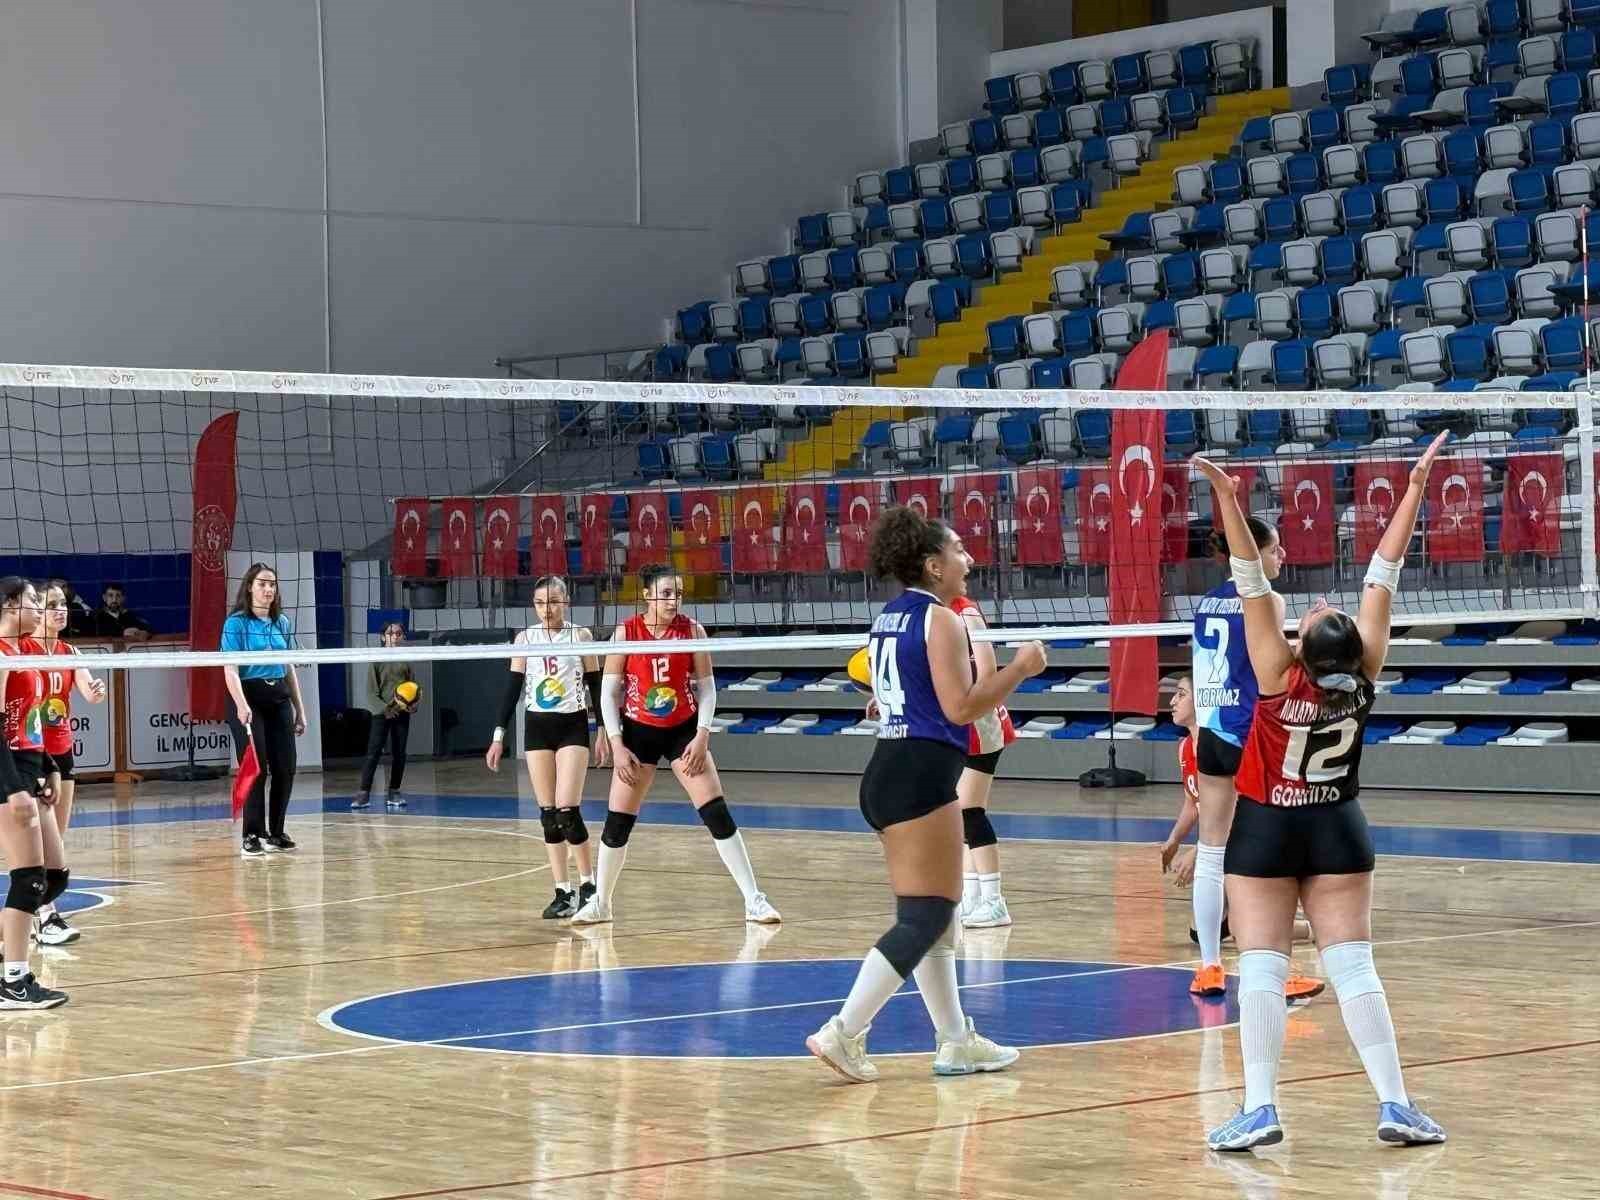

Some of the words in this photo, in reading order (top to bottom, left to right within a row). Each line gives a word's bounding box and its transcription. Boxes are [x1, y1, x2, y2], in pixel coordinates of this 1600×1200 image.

[542, 655, 558, 675] 16
[651, 656, 670, 682] 12
[869, 637, 906, 724] 14
[70, 717, 90, 731] OR
[157, 734, 169, 752] İL
[1282, 717, 1358, 782] 12
